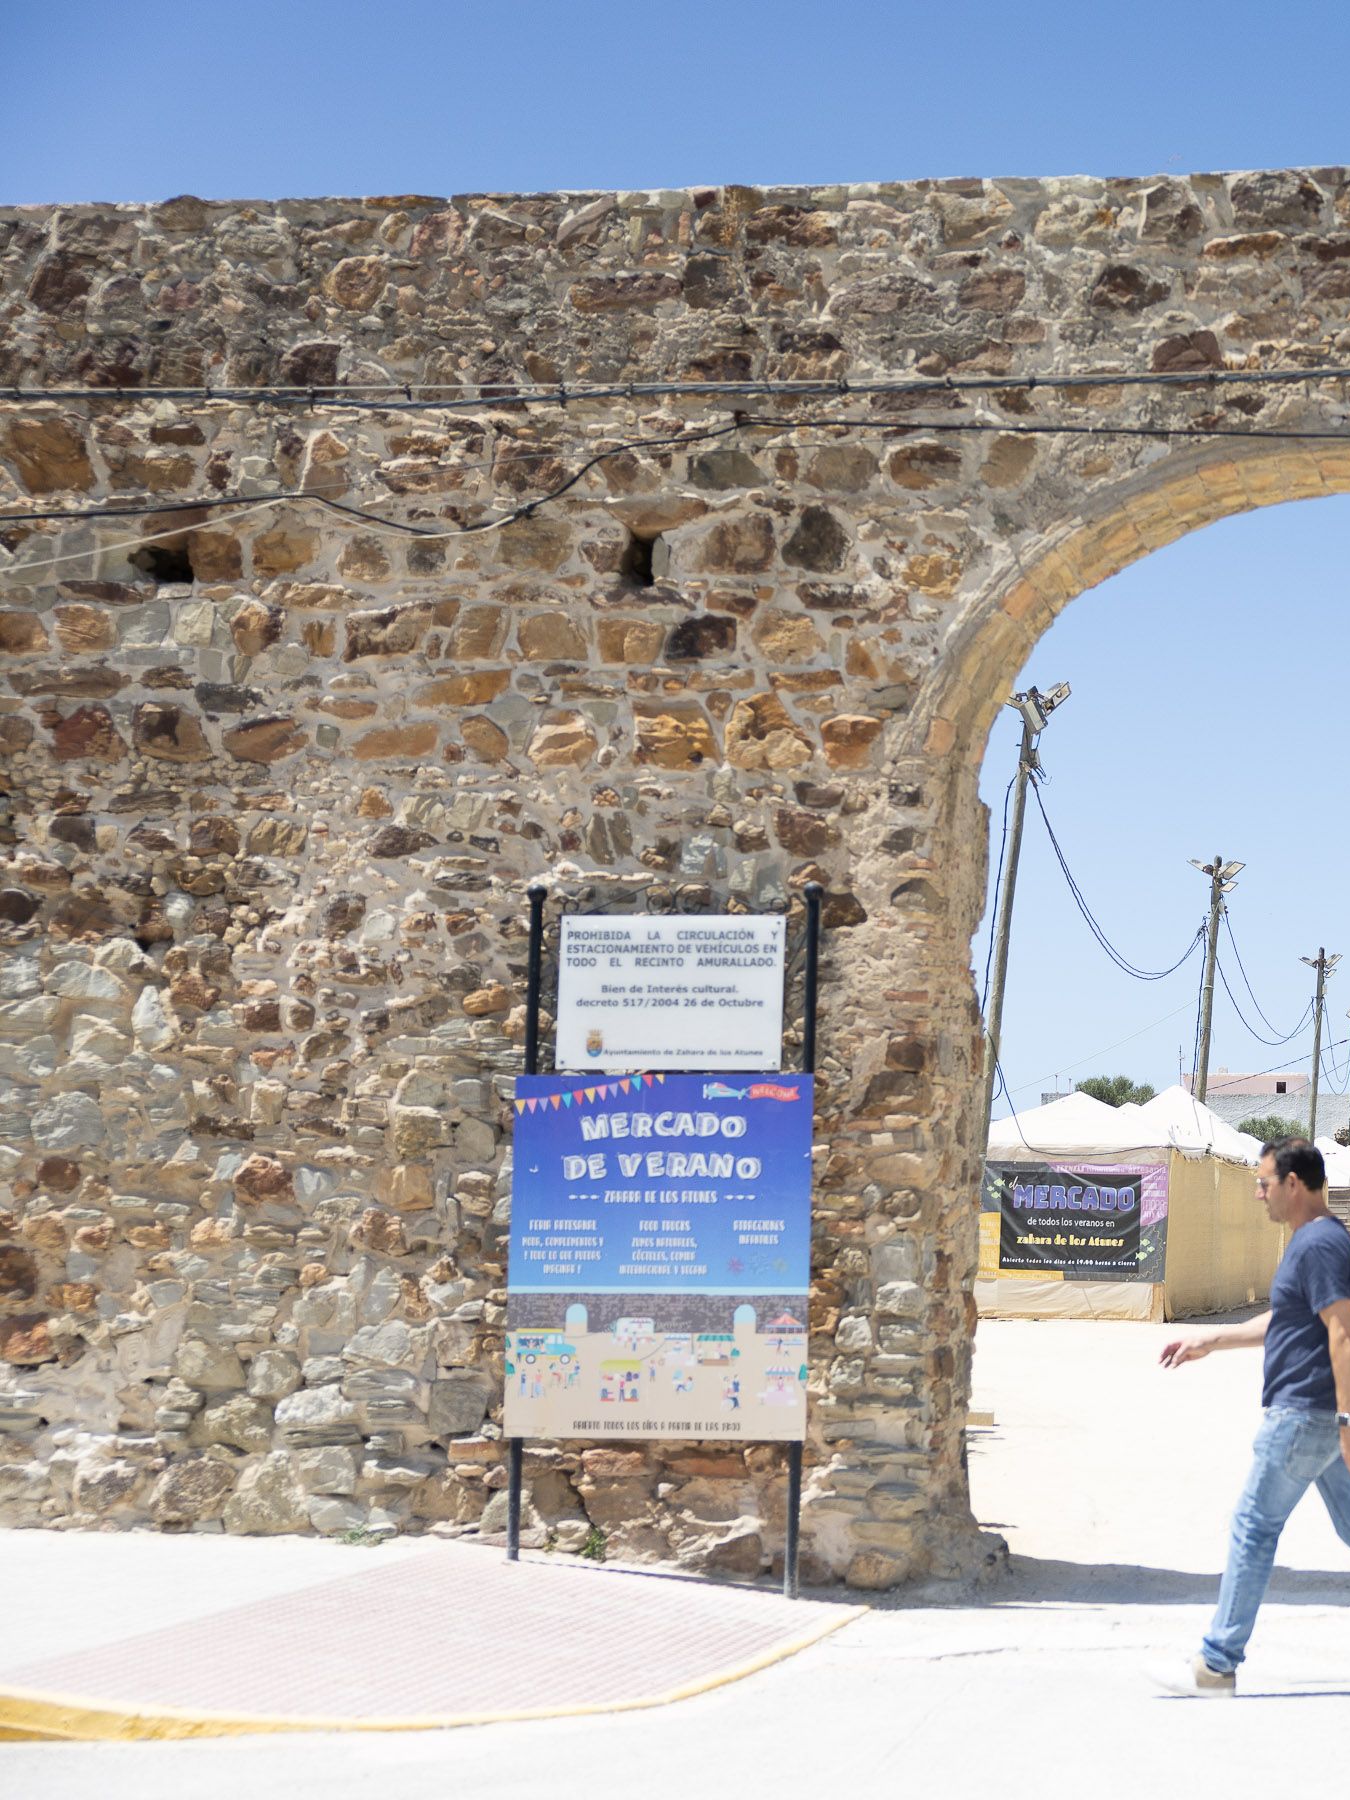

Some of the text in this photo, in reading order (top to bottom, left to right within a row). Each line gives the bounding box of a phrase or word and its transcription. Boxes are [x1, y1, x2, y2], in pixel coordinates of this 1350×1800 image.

[567, 929, 778, 940] PROHIBIDA LA CIRCULACIÓN Y
[566, 942, 777, 954] ESTACIONAMIENTO DE VEHÍCULOS EN
[566, 957, 777, 968] TODO EL RECINTO AMURALLADO.
[601, 984, 739, 994] Bien de Interés cultural.
[576, 998, 764, 1008] decreto 517/2004 26 de Octubre
[580, 1111, 747, 1141] MERCADO
[562, 1151, 762, 1180] DE VERANO
[603, 1190, 718, 1204] ZAHARA DE LOS ATUNES
[1013, 1184, 1135, 1211] MERCADO
[1027, 1217, 1037, 1226] de
[1038, 1217, 1060, 1227] todos
[1061, 1217, 1073, 1227] los
[1074, 1219, 1104, 1228] veranos
[1016, 1233, 1125, 1247] zahara de los Atunes
